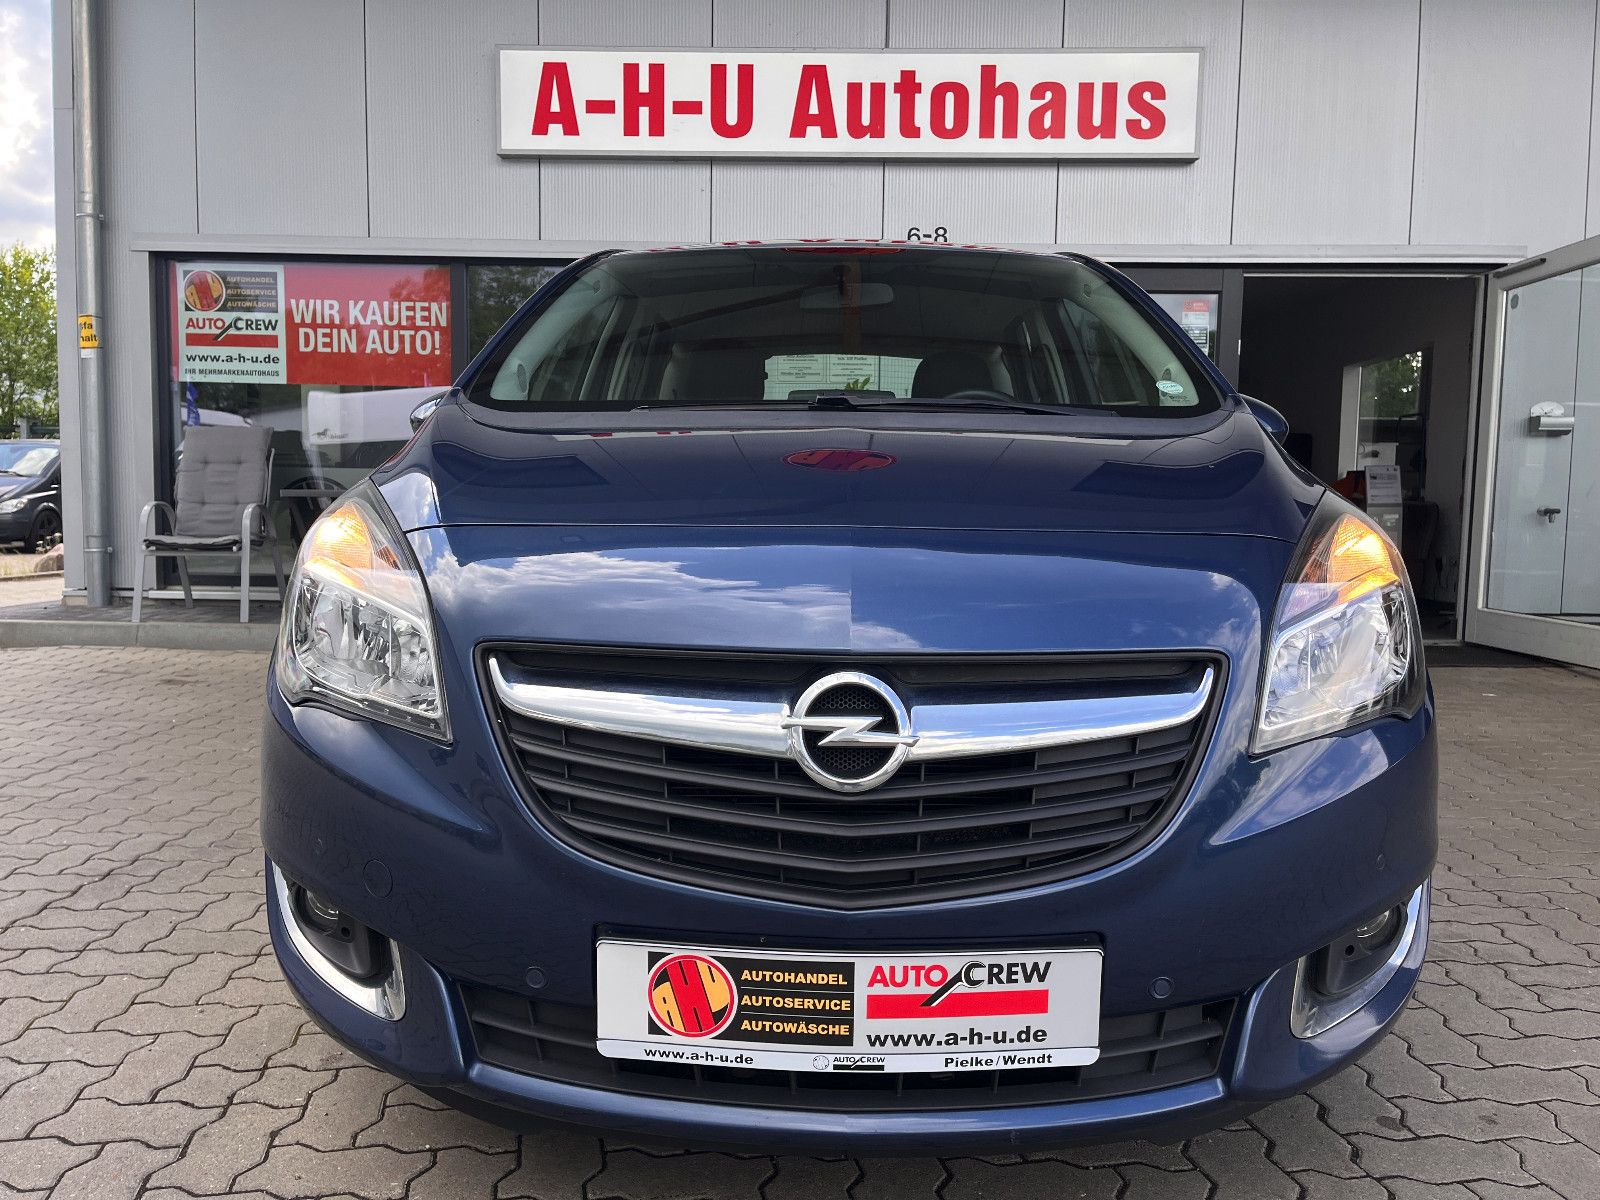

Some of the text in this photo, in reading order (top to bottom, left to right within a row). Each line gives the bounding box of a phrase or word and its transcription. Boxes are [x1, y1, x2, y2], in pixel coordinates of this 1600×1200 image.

[531, 62, 1167, 139] A-H-U Autohaus
[907, 226, 948, 242] 6-8
[226, 288, 277, 296] AUTOSERVICE
[290, 299, 447, 327] WIR KAUFEN
[186, 317, 279, 331] AUTO CREW
[298, 327, 440, 356] DEIN AUTO!
[186, 353, 280, 364] www.a-h-u.de
[184, 367, 280, 377] IHR MEHRMARKENAUTOHAUS
[741, 969, 848, 986] AUTOHANDEL
[867, 960, 1052, 988] AUTO CREW
[741, 994, 851, 1012] AUTOSERVICE
[741, 1018, 850, 1036] AUTOWÄSCHE
[866, 1025, 1048, 1047] www.a-h-u.de
[644, 1048, 754, 1065] www.a-h-u.de
